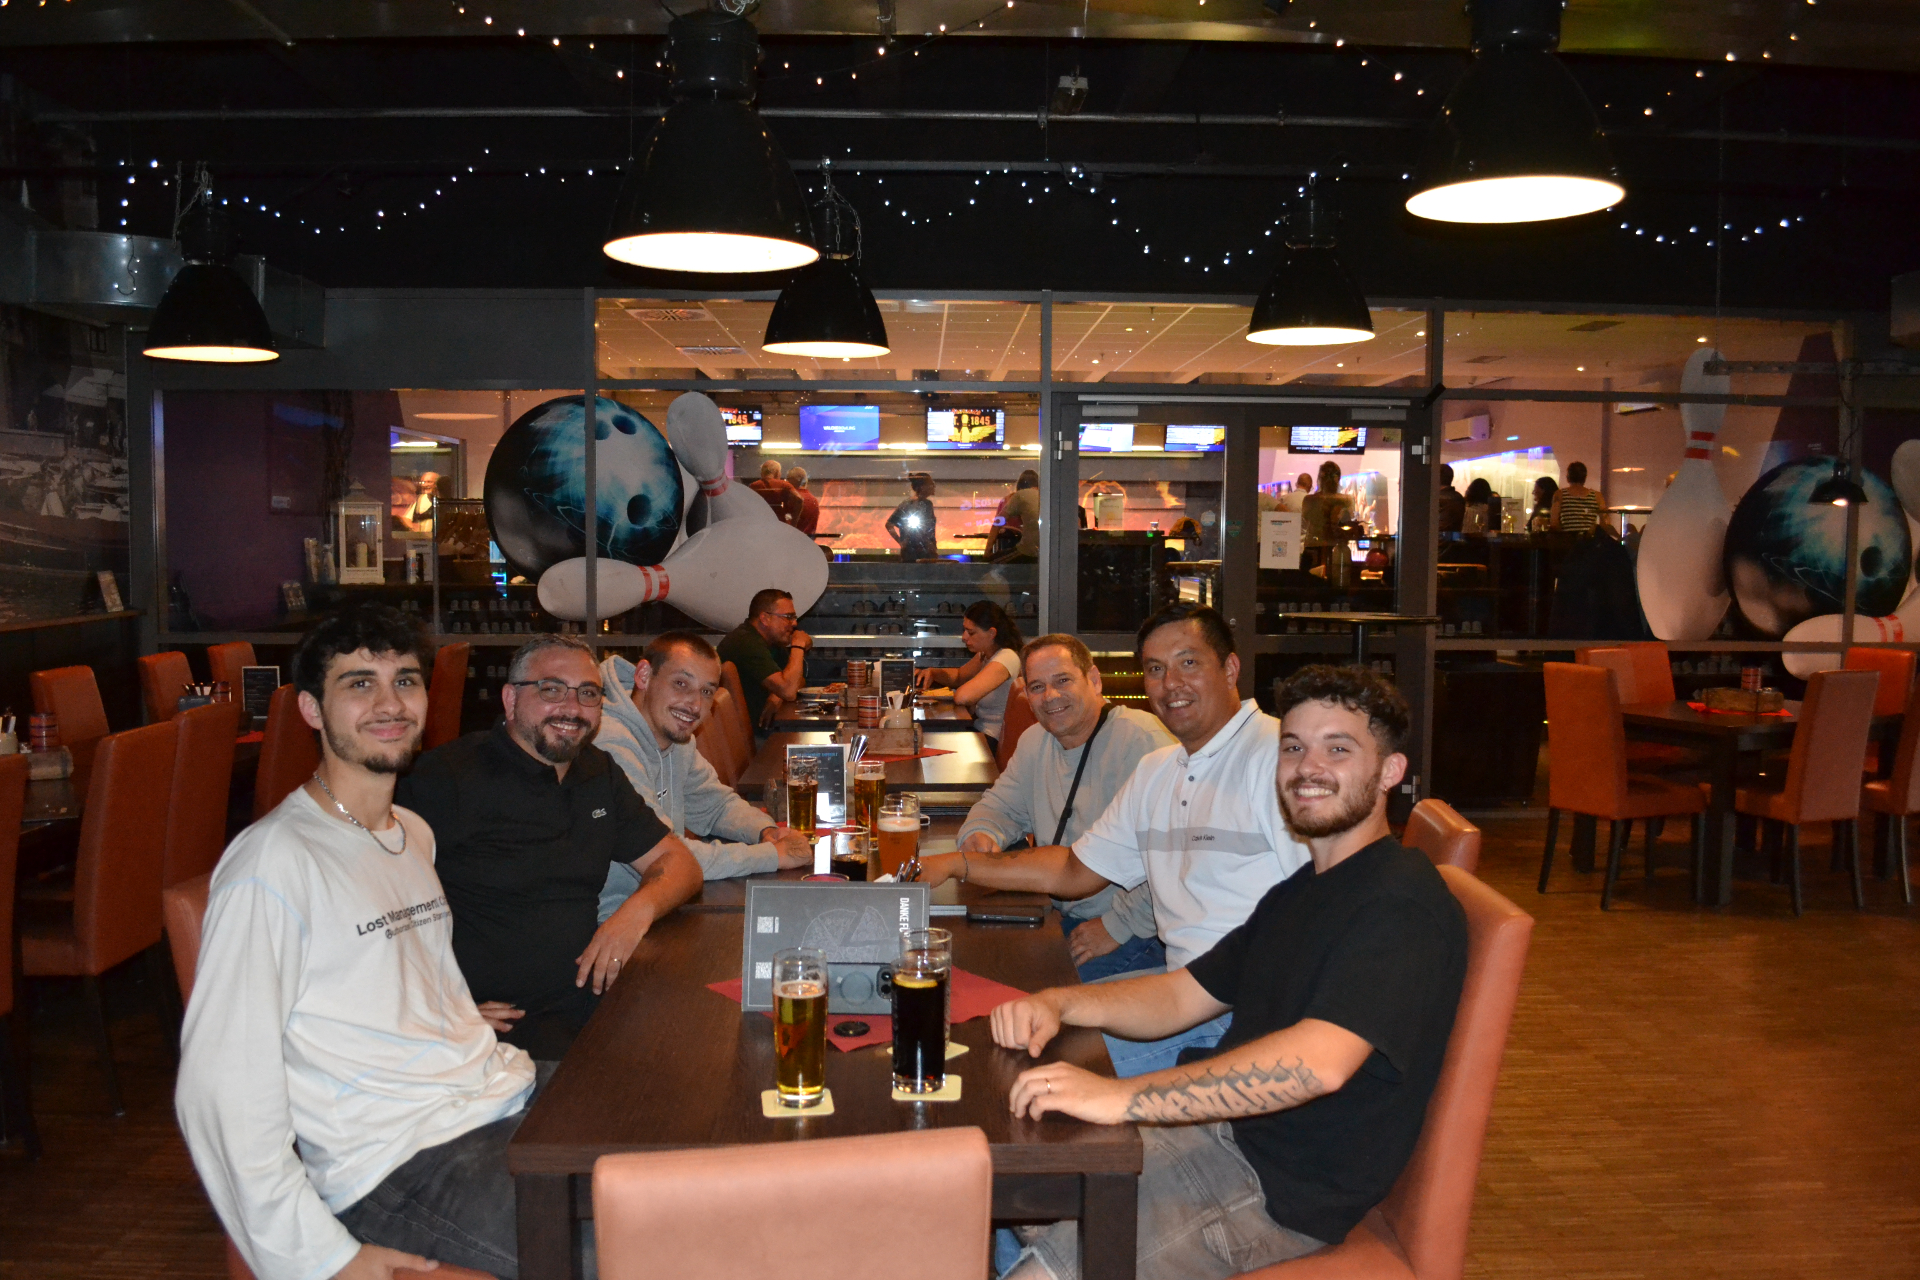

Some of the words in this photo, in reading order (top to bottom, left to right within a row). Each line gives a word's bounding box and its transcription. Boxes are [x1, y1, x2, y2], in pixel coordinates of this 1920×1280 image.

[970, 416, 991, 426] 1845
[900, 897, 910, 922] DANKE
[356, 915, 389, 936] Lost
